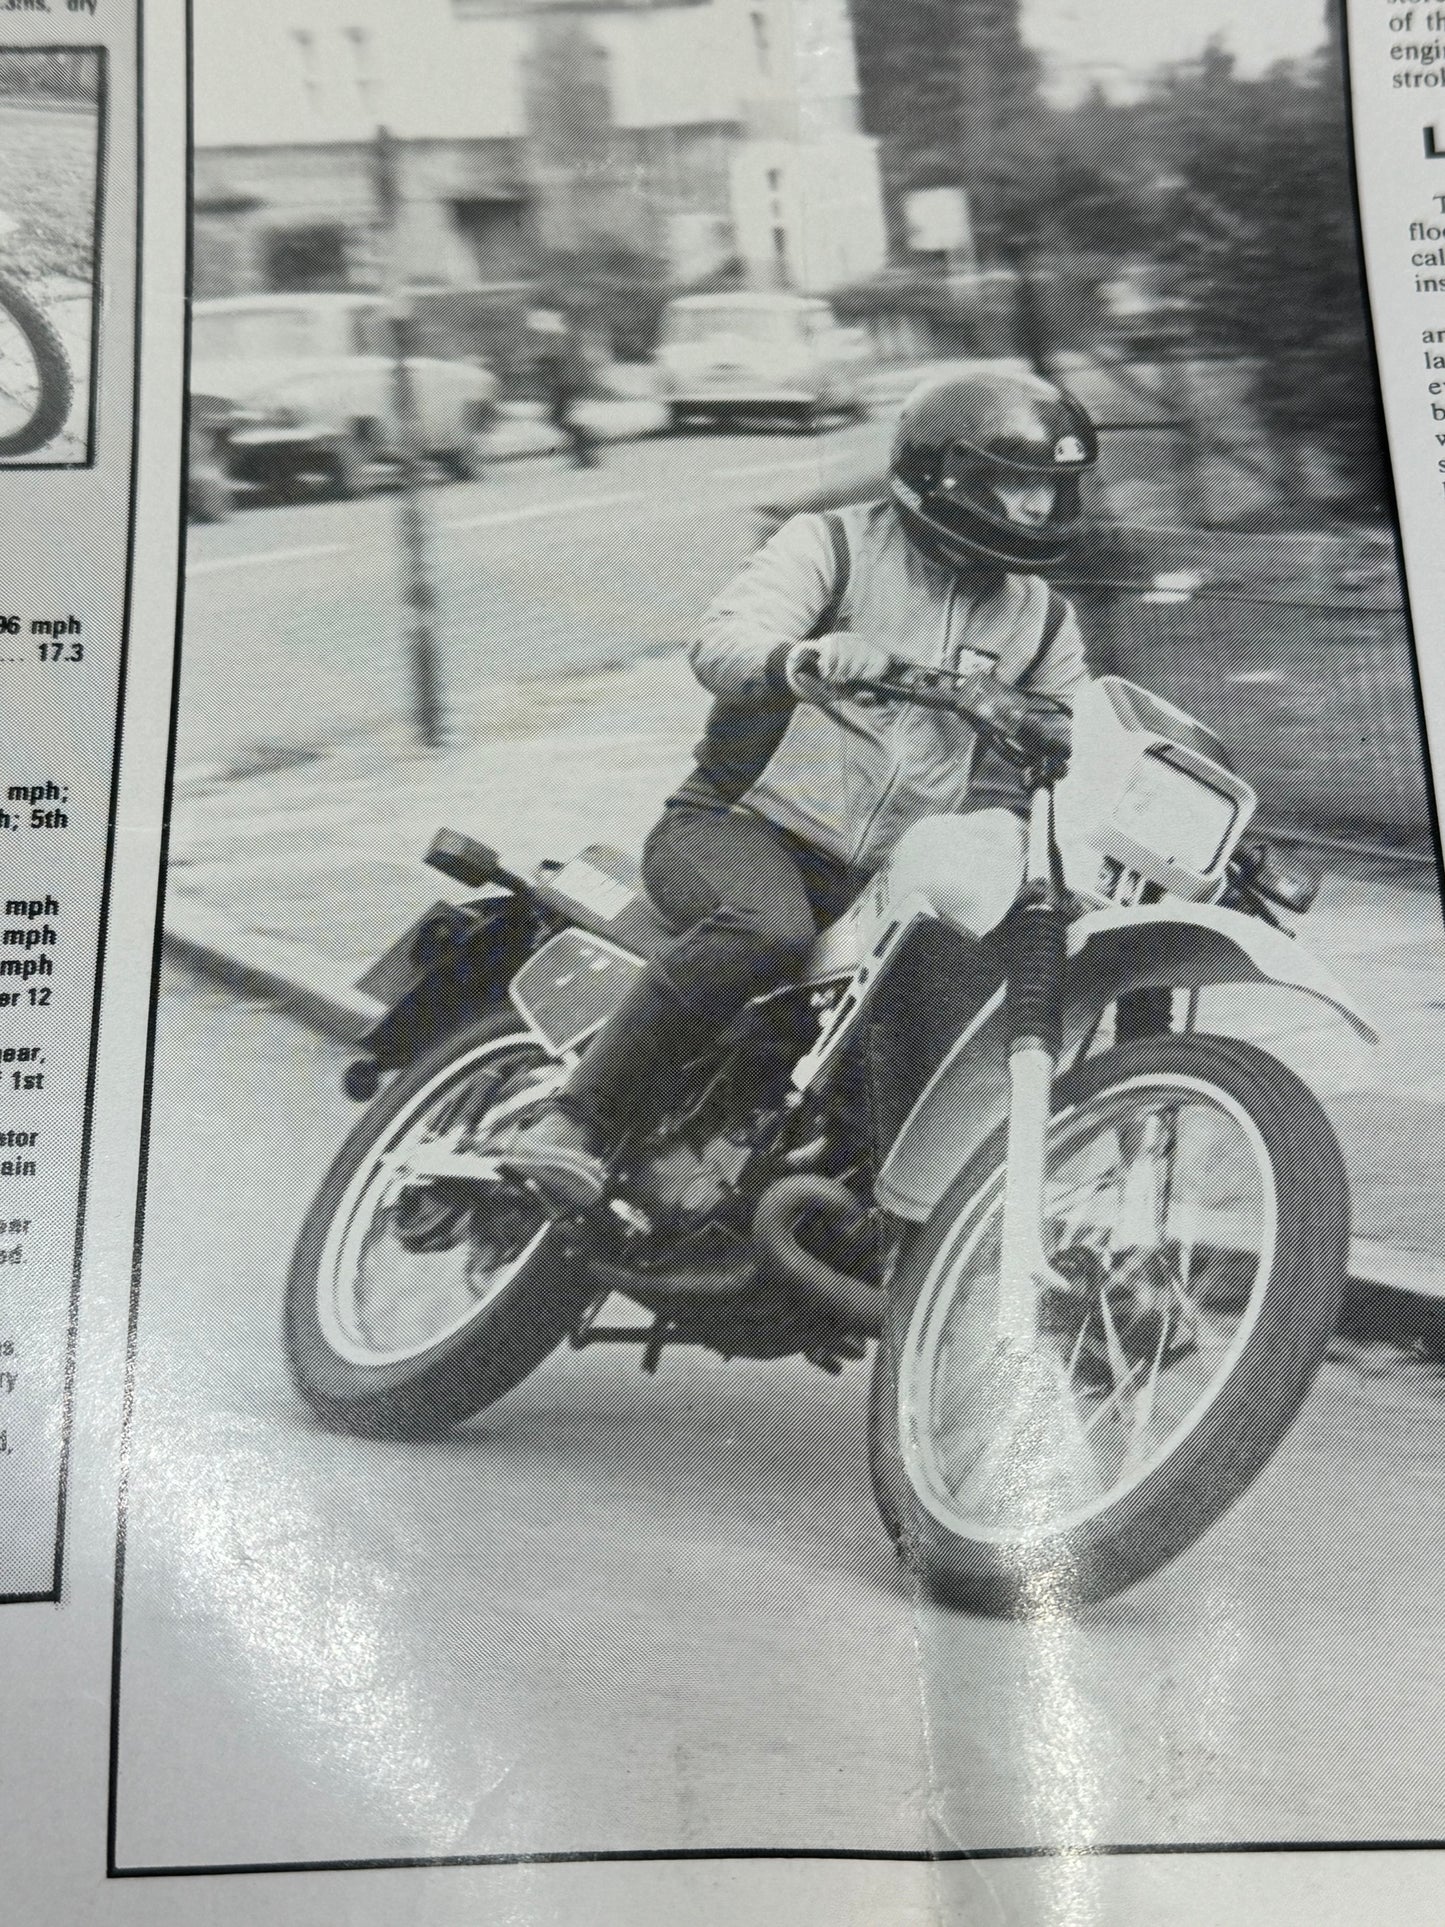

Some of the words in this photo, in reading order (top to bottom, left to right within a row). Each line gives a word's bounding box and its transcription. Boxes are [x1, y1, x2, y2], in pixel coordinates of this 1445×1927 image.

[1389, 11, 1413, 32] of
[1390, 39, 1445, 66] engi
[1409, 222, 1445, 241] flo
[31, 615, 82, 640] mph
[38, 643, 84, 662] 17.3
[8, 780, 69, 806] mph;
[31, 808, 69, 829] 5th
[5, 895, 59, 920] mph
[2, 924, 57, 950] mph
[0, 953, 53, 981] mph
[28, 987, 52, 1007] 12
[0, 1047, 46, 1064] ear,
[11, 1070, 45, 1090] 1st
